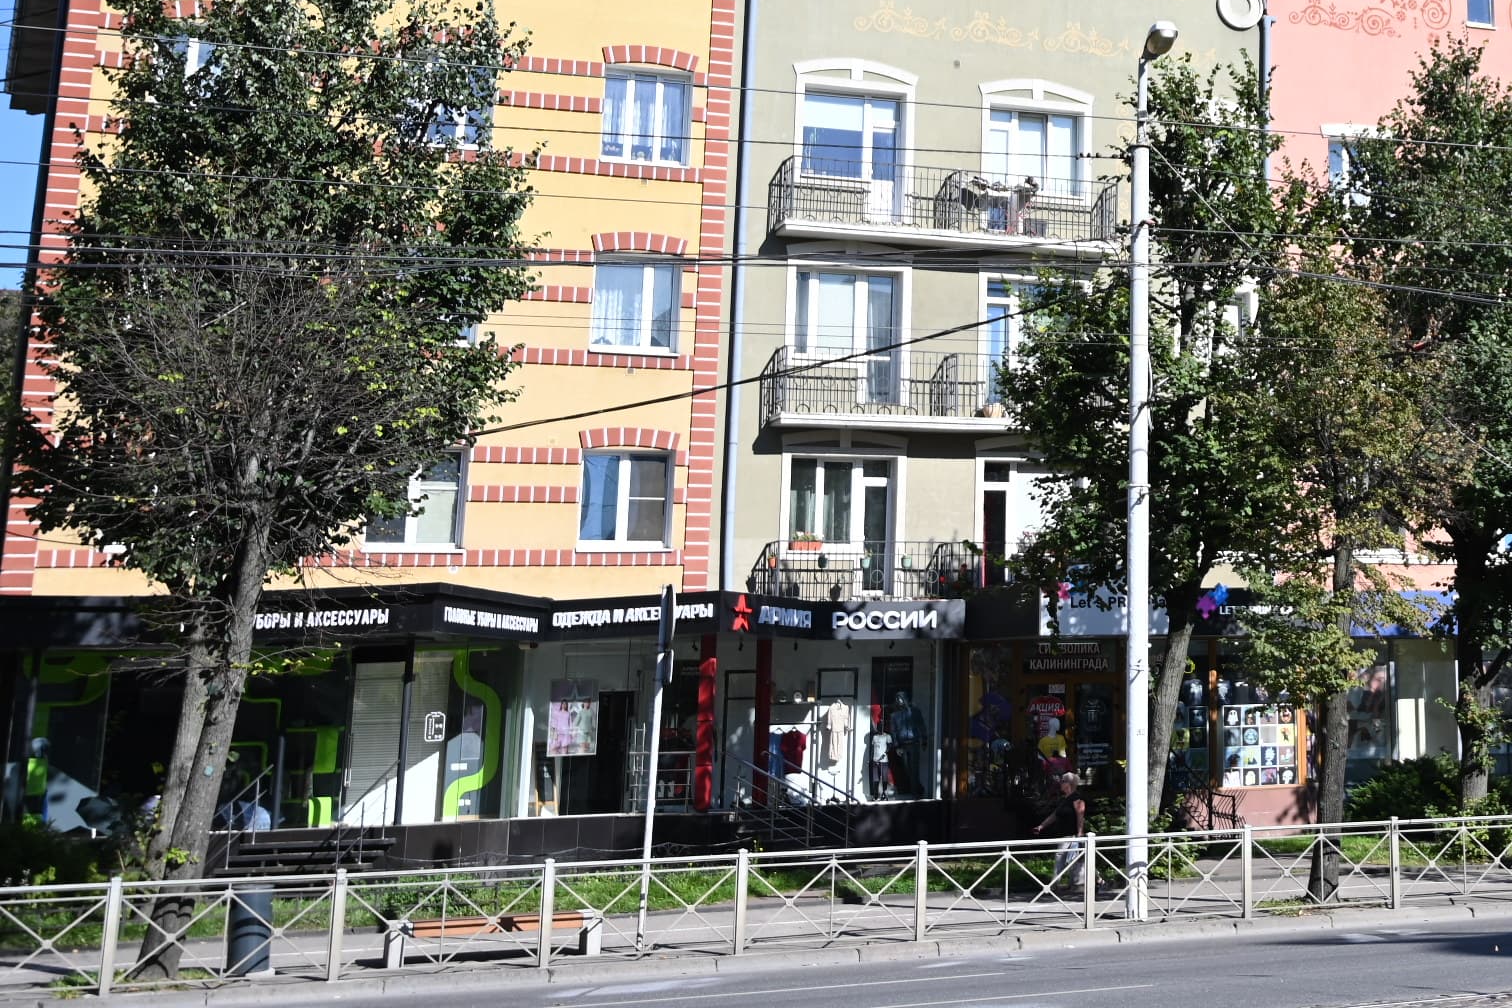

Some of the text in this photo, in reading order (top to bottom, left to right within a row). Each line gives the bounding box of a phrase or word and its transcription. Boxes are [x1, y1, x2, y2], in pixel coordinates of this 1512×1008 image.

[294, 612, 303, 628] И
[306, 608, 389, 626] АКСЕССУАРЫ
[553, 604, 714, 628] ОДЕЖДА И АКСЕУАРЫ
[758, 605, 812, 629] АРМИЯ
[832, 609, 938, 630] РОССИИ
[1039, 642, 1100, 654] СИВОЛИКА
[1030, 658, 1109, 671] КАЛИНИНГРАДА
